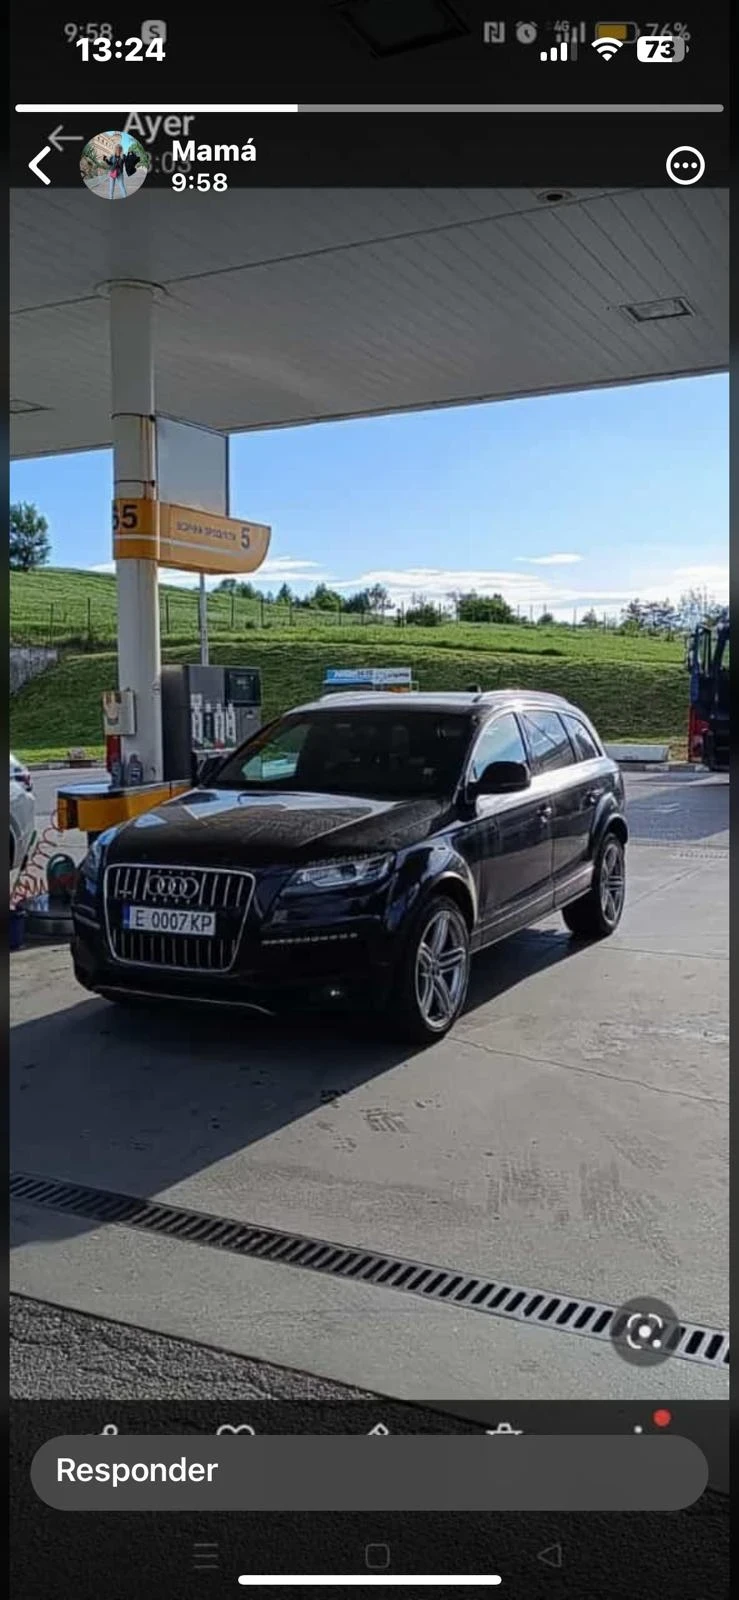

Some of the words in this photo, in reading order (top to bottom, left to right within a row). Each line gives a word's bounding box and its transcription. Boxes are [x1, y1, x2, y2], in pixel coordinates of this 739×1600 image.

[240, 526, 251, 549] 5
[135, 909, 145, 928] E
[151, 910, 187, 931] 0007
[190, 912, 213, 932] KP
